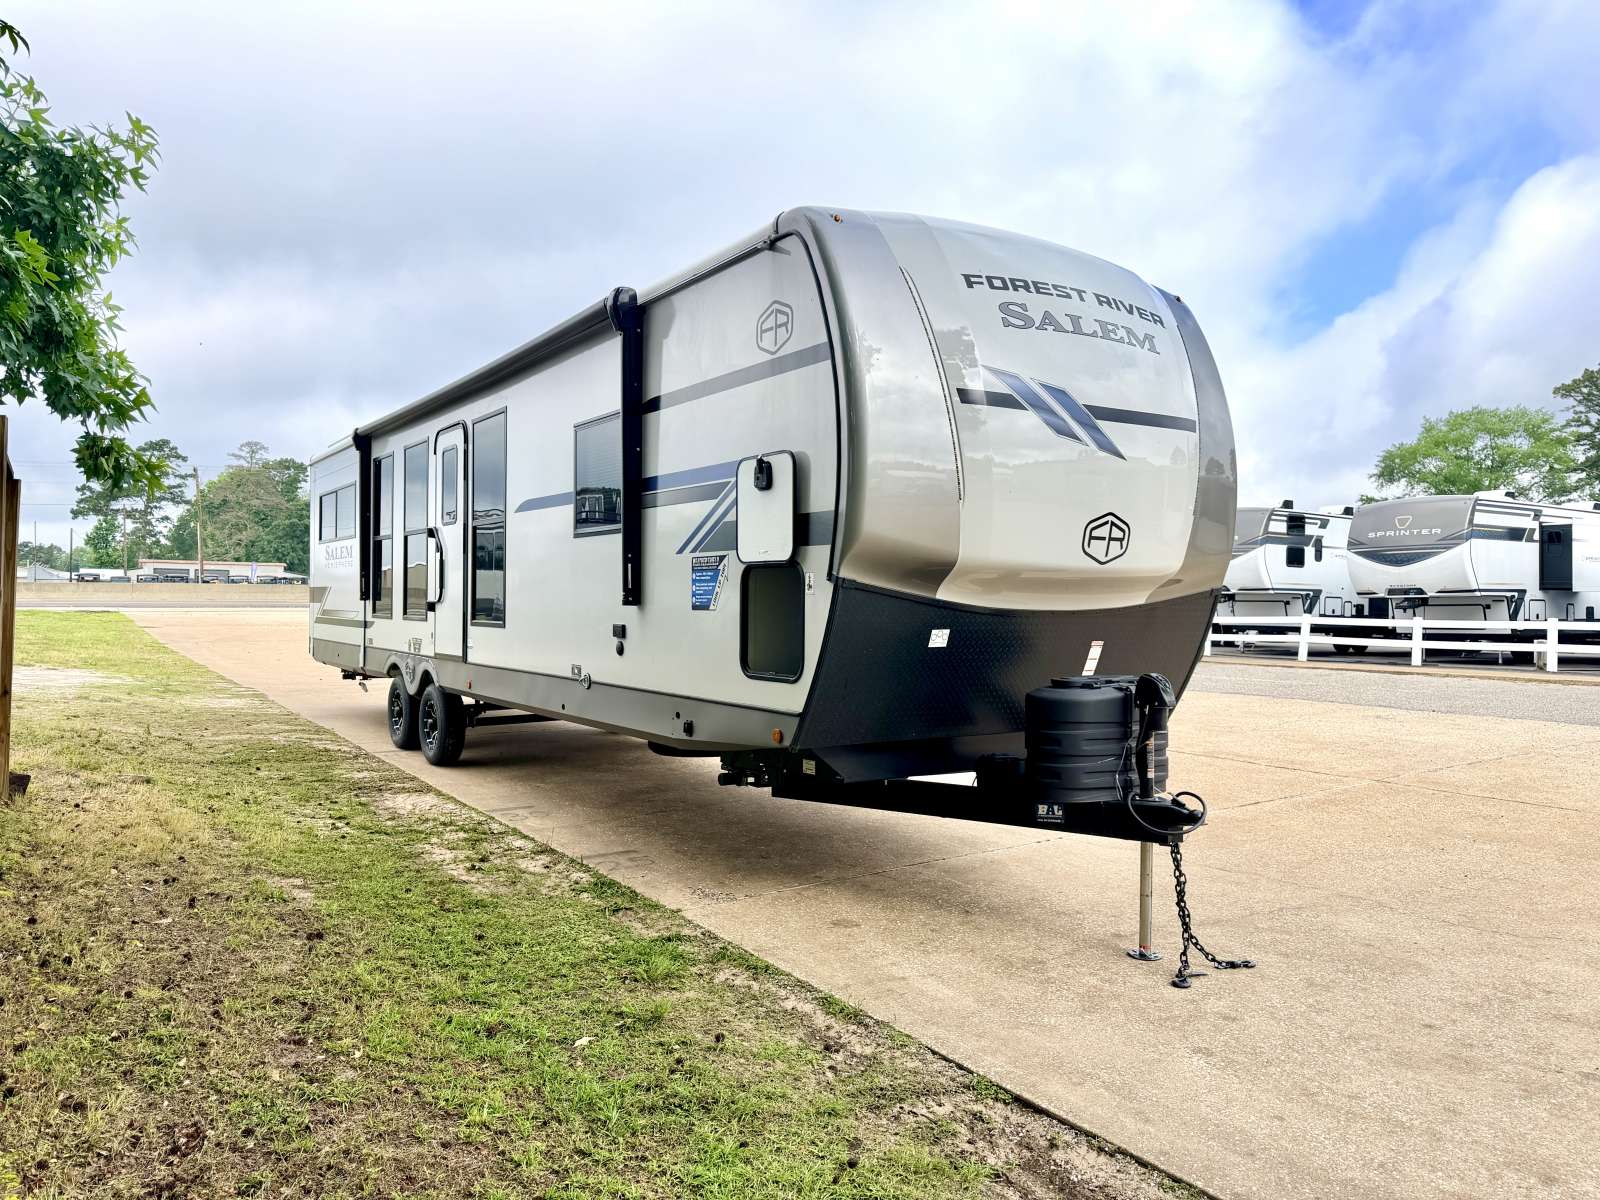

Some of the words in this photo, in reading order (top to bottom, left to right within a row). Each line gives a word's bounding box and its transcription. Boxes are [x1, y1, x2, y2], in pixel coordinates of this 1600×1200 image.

[960, 273, 1087, 302] FOREST
[1092, 292, 1166, 328] RIVER
[998, 301, 1161, 355] SALEM
[1367, 528, 1442, 538] SPRINTER
